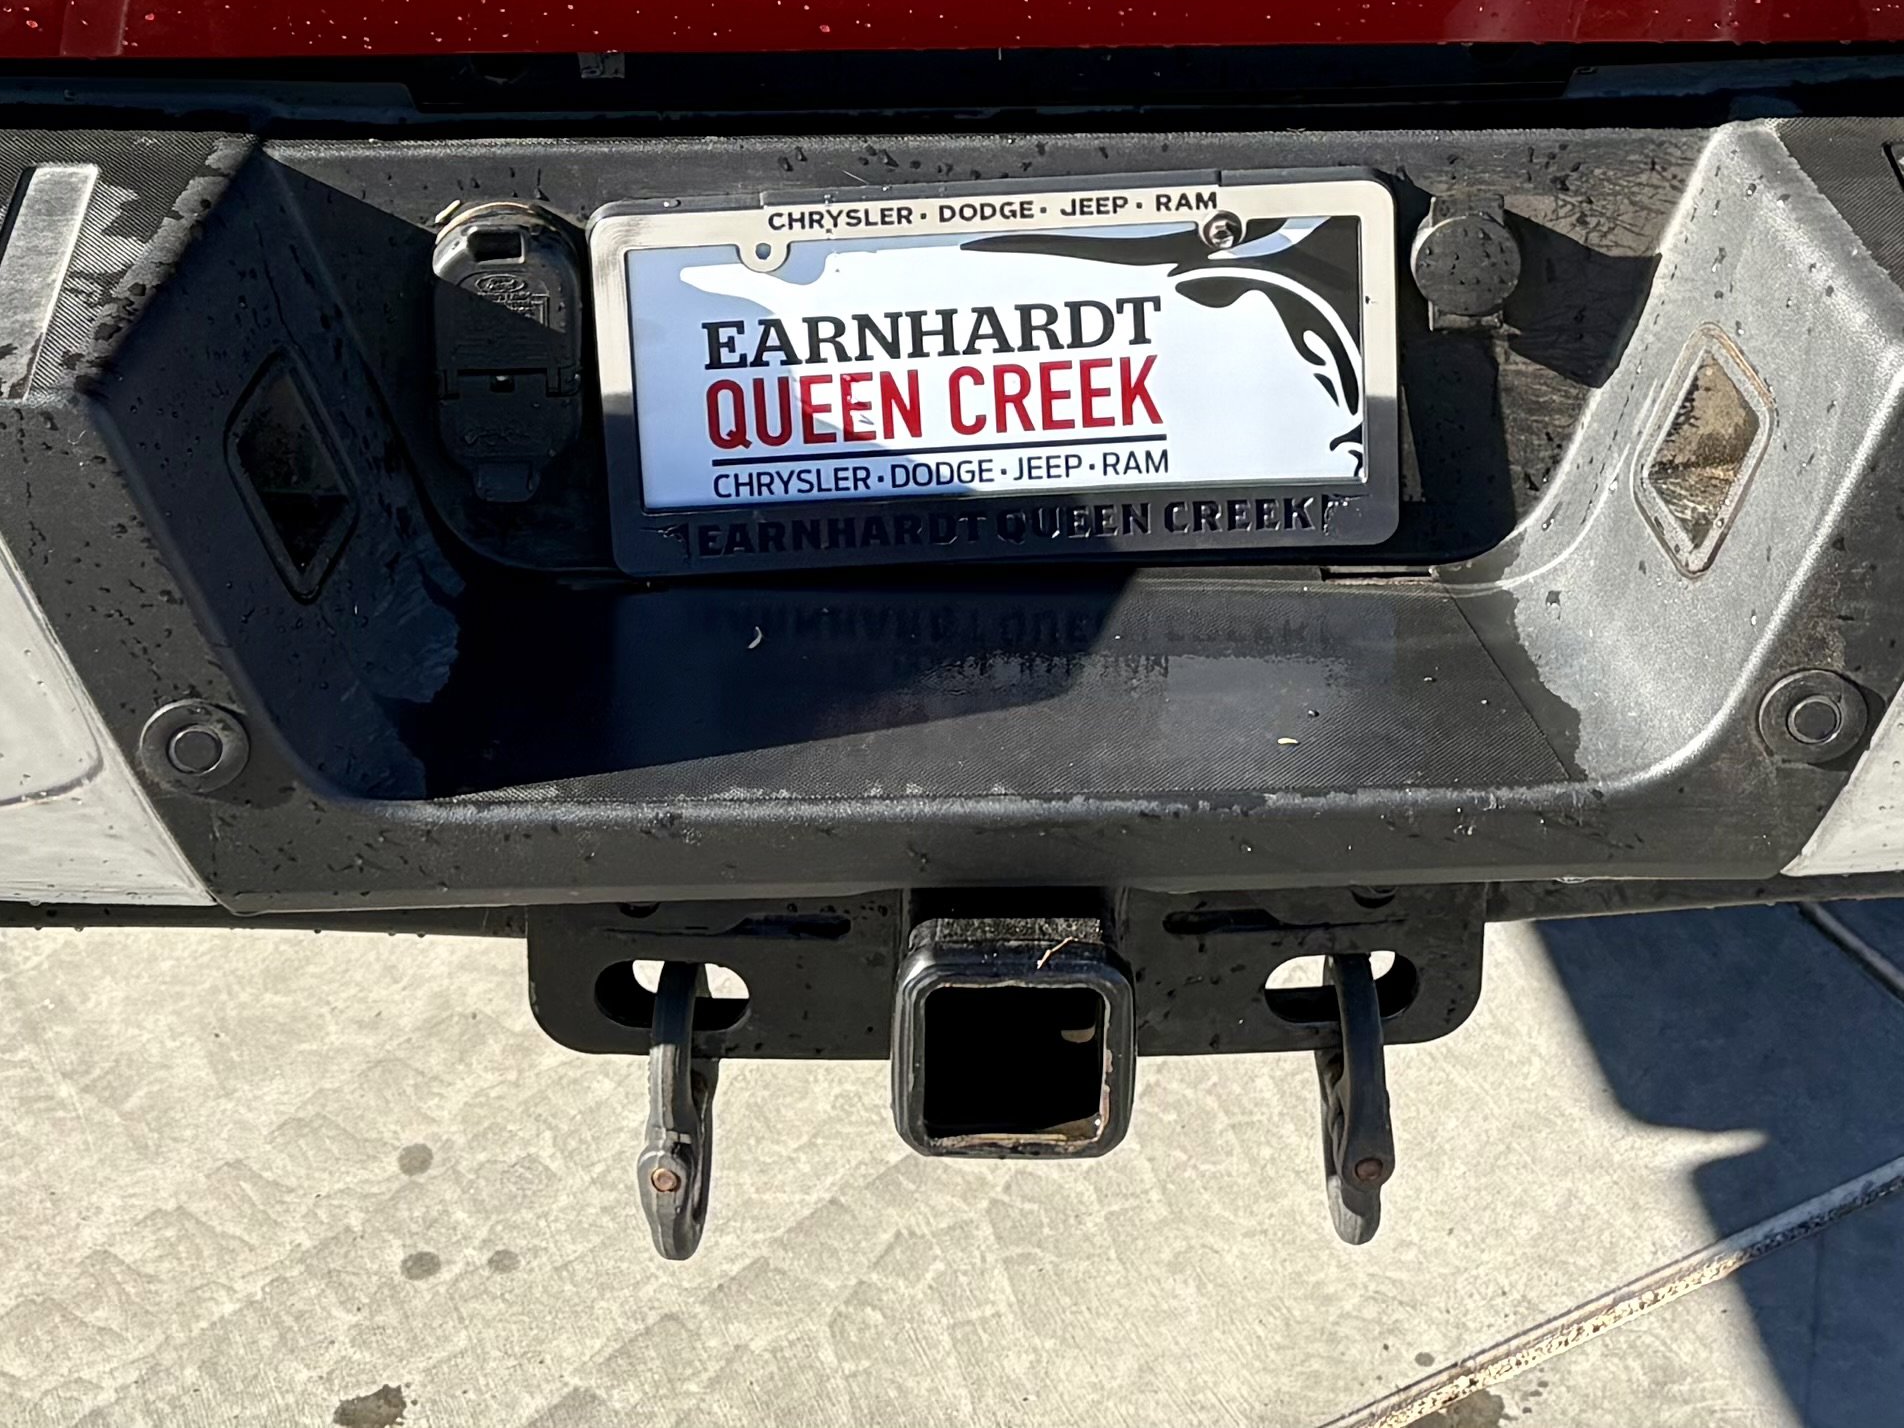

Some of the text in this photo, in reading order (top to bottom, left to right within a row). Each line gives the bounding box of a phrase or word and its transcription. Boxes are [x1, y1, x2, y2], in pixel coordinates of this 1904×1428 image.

[767, 191, 1218, 233] CHRYSLER DODGE JEEP RAM
[702, 295, 1162, 370] EARNHARDT
[706, 355, 1163, 450] QUEEN CREEK
[712, 449, 1169, 499] CHRYSLER DODGE JEEP RAM
[699, 496, 1312, 558] EARNHARDT QUEEN CREEK
